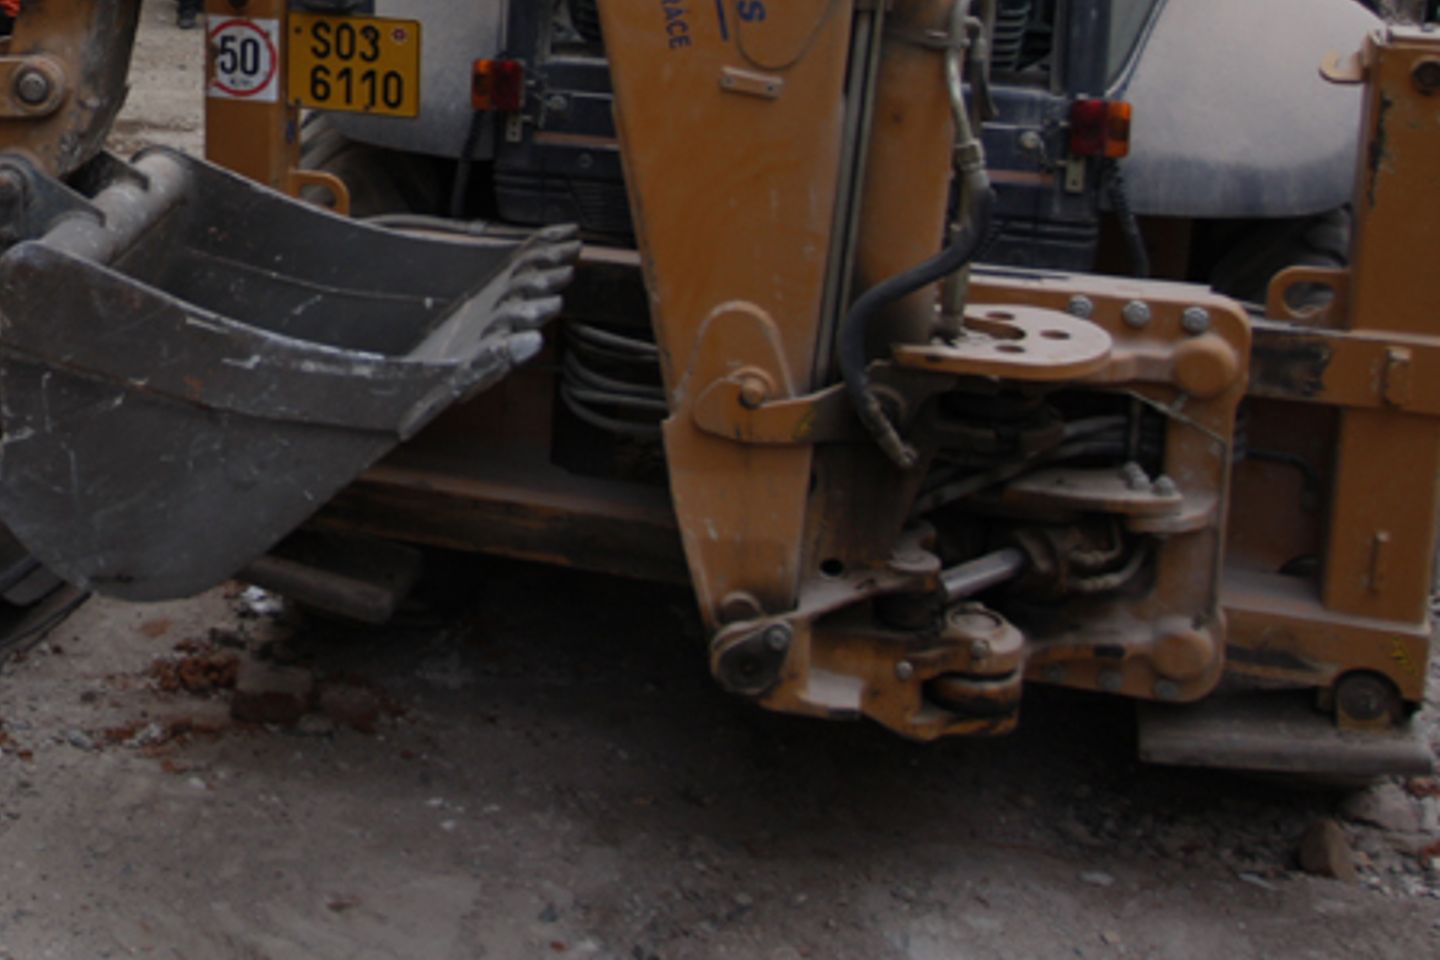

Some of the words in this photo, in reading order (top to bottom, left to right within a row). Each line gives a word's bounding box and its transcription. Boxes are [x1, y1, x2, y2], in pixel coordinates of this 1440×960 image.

[219, 35, 259, 76] 50
[310, 20, 380, 62] S03
[310, 65, 403, 109] 6110
